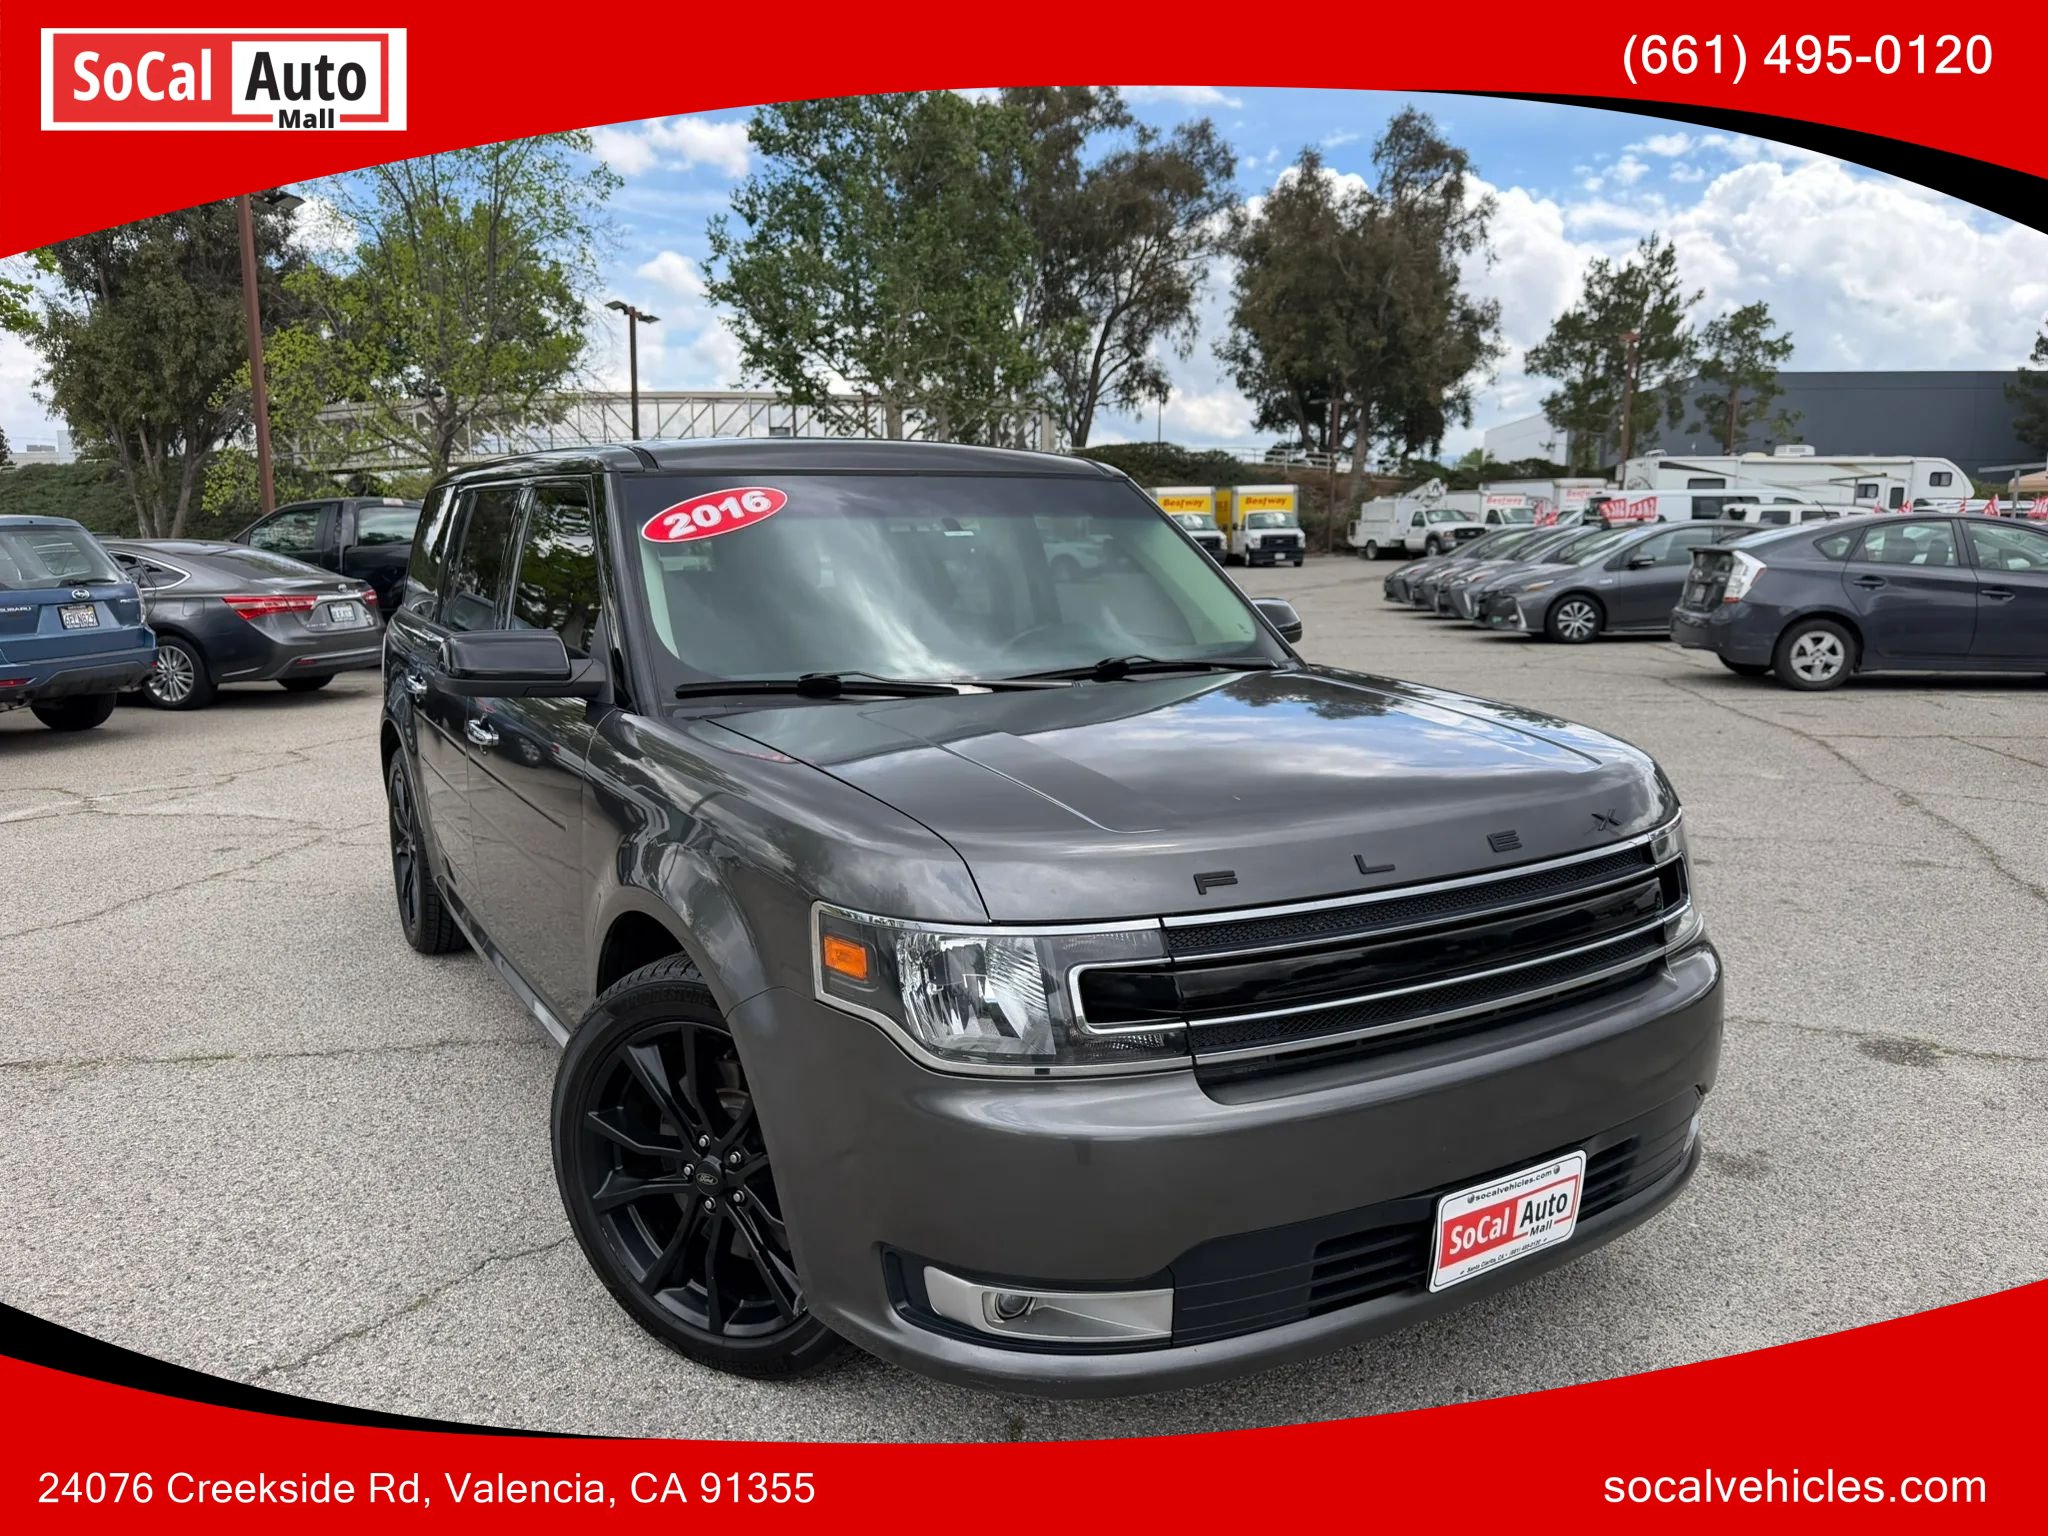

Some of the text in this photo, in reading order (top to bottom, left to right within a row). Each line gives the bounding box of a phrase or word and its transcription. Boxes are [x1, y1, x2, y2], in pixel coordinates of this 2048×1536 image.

[1162, 498, 1205, 508] Bestway
[1244, 496, 1288, 506] Bestway
[663, 490, 772, 539] 2016
[1475, 1170, 1552, 1201] socalvehicles.com
[1449, 1193, 1568, 1255] SoCal Auto
[1529, 1220, 1553, 1237] Mall
